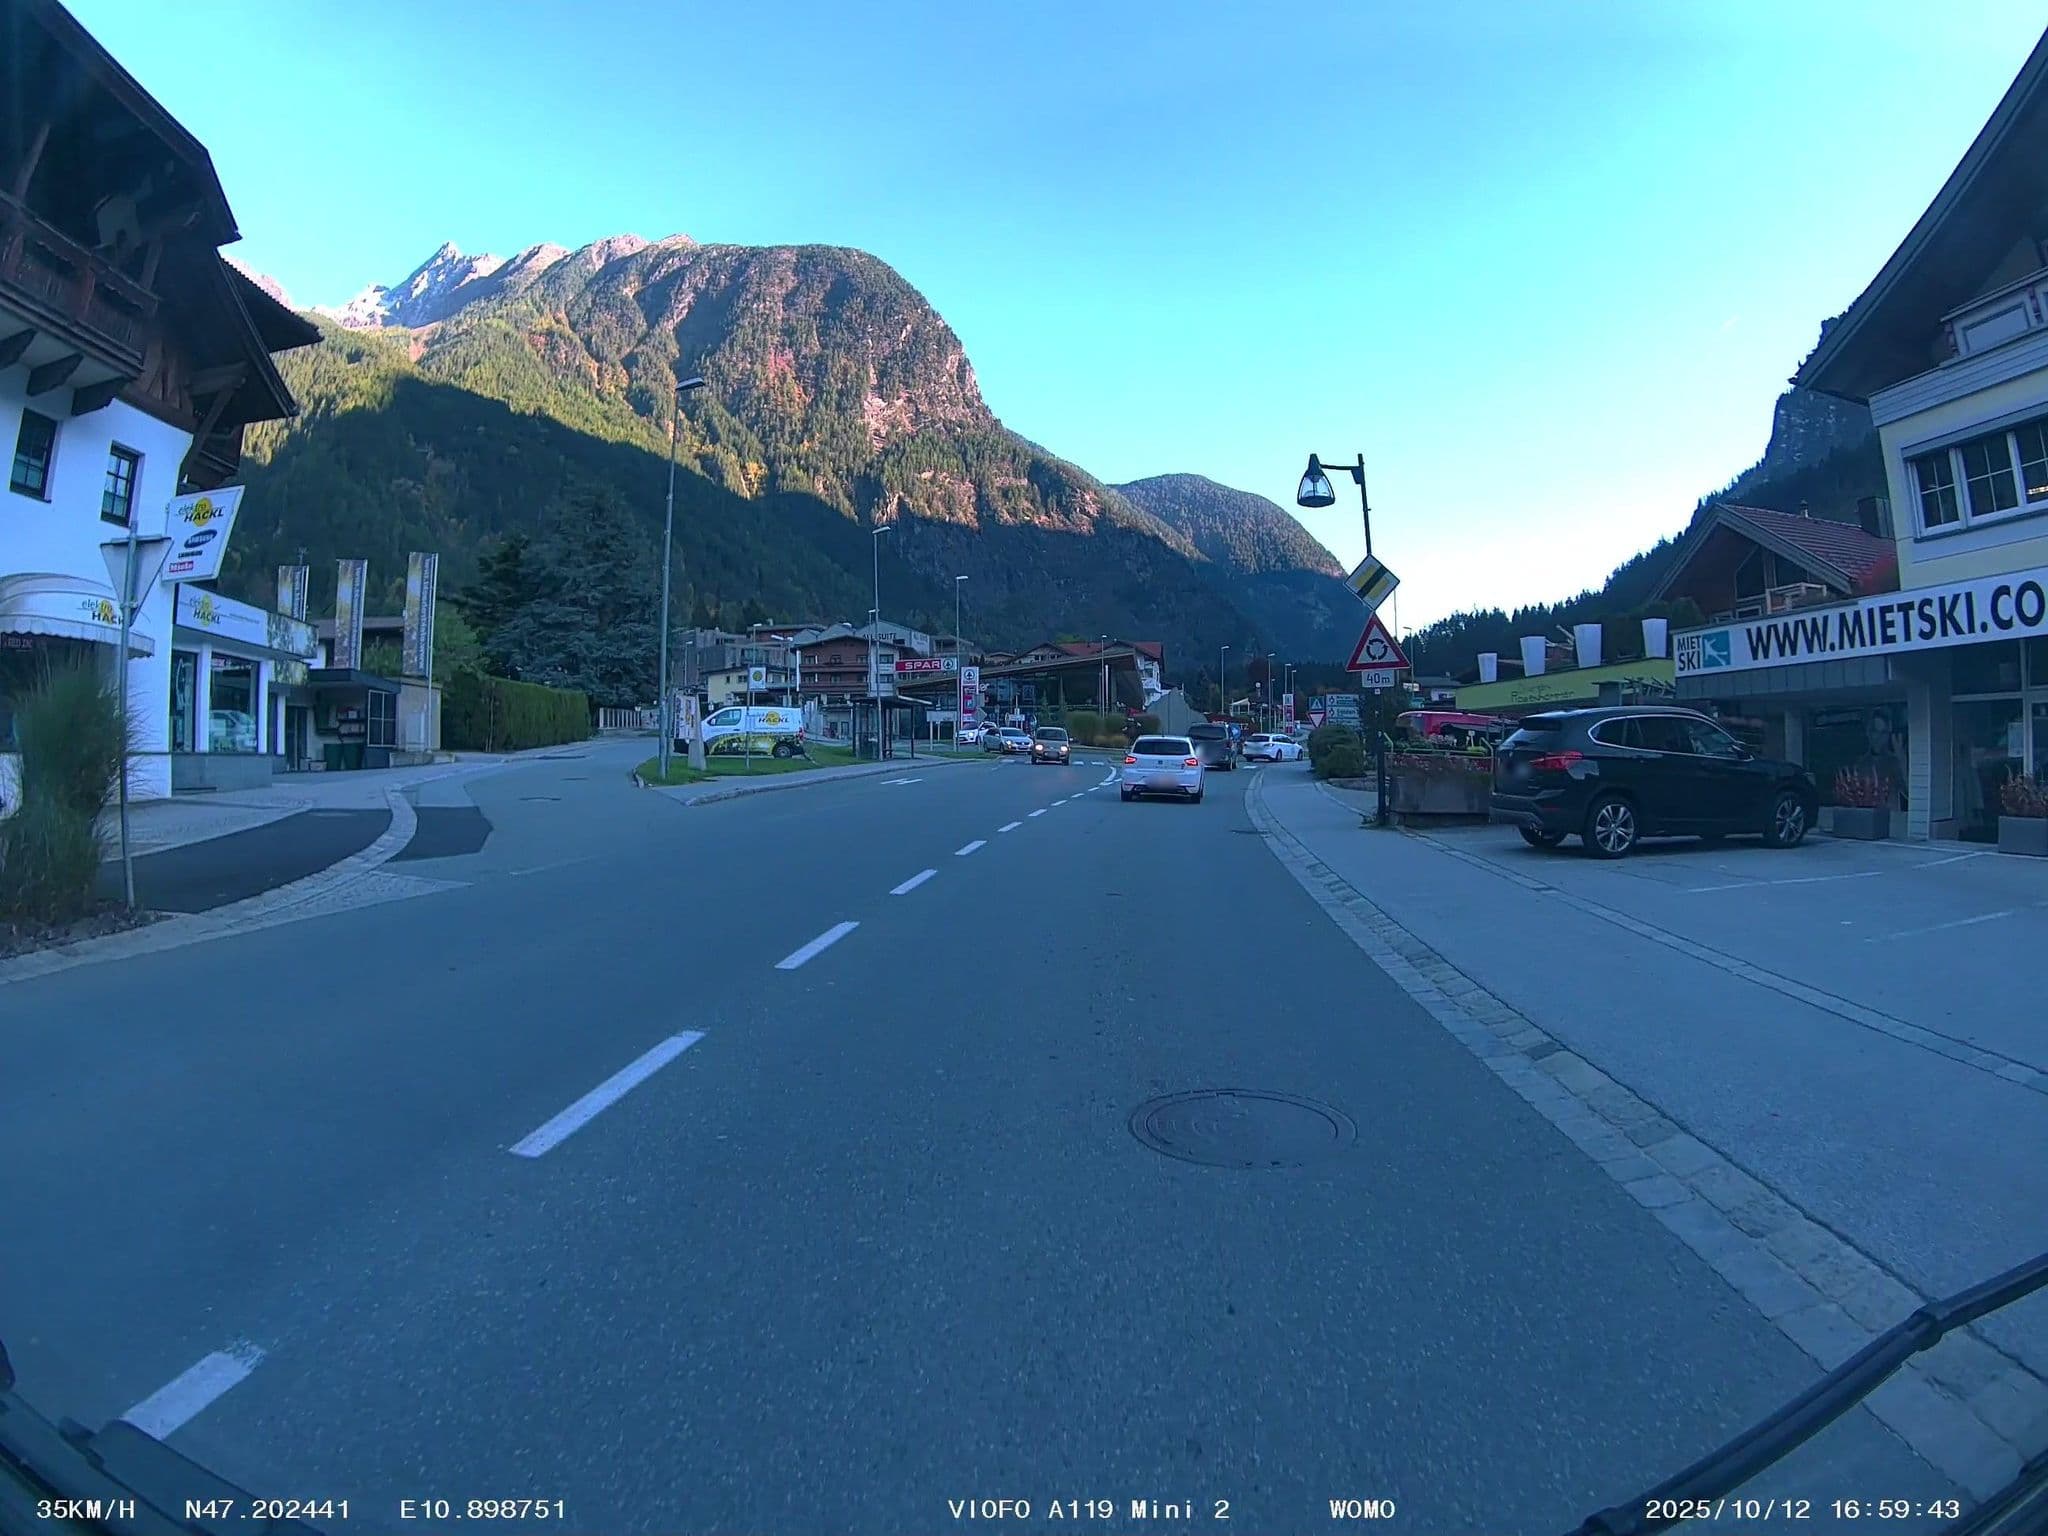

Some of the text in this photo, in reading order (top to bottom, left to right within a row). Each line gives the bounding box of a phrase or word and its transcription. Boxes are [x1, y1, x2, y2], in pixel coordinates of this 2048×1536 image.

[184, 507, 225, 522] HACKL
[1677, 636, 1701, 652] MIET
[905, 661, 940, 670] SPAR
[1678, 651, 1701, 671] SKI
[1367, 673, 1380, 684] 40
